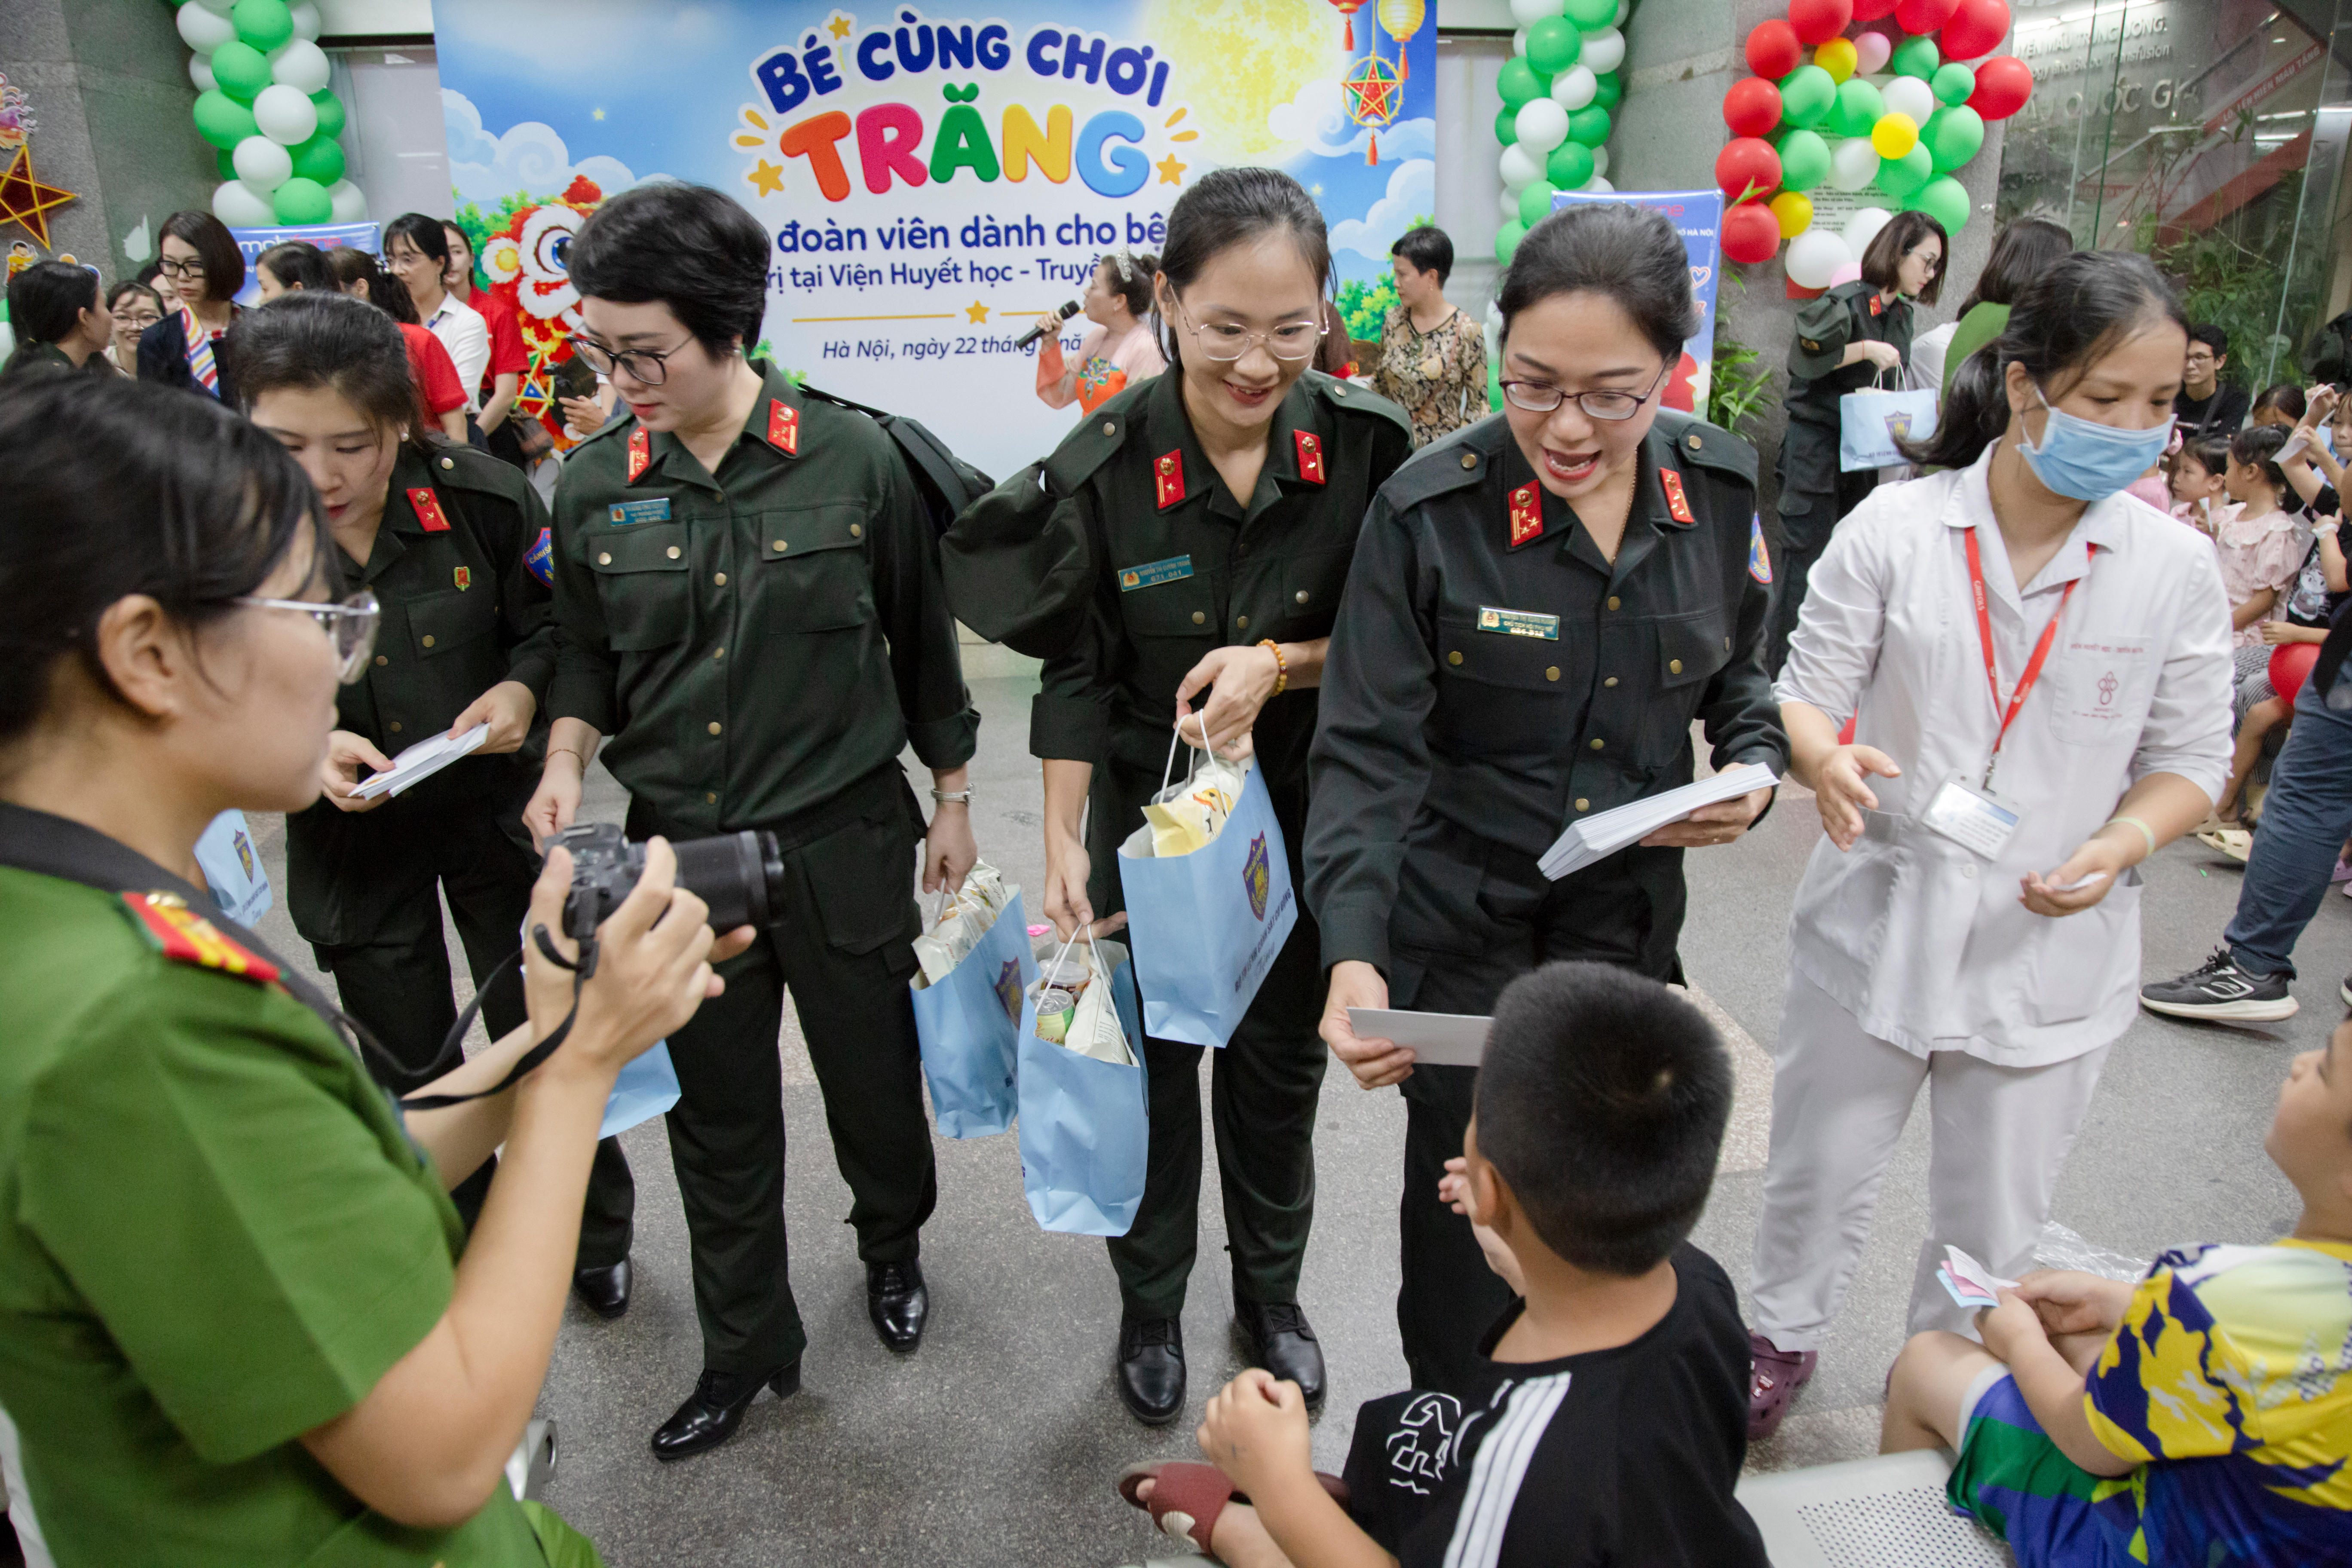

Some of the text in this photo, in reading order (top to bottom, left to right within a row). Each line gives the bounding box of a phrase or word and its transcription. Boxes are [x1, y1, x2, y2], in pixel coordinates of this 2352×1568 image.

[756, 11, 1170, 114] BÉ CÙNG CHƠI
[780, 83, 1150, 202] TRĂNG
[777, 217, 867, 252] đoàn
[877, 217, 949, 250] viên
[960, 213, 1045, 248] dành
[1056, 213, 1117, 246] cho
[1687, 227, 1698, 236] HÀ
[1700, 228, 1714, 237] NỘI
[766, 266, 783, 294] rị
[789, 264, 822, 293] tại
[829, 263, 883, 292] Viện
[891, 257, 963, 290] Huyết
[970, 260, 1013, 288] học
[823, 341, 851, 359] Hà
[857, 340, 895, 361] Nội,
[903, 337, 950, 360] ngày
[954, 337, 977, 355] 22
[1060, 333, 1087, 351] nă
